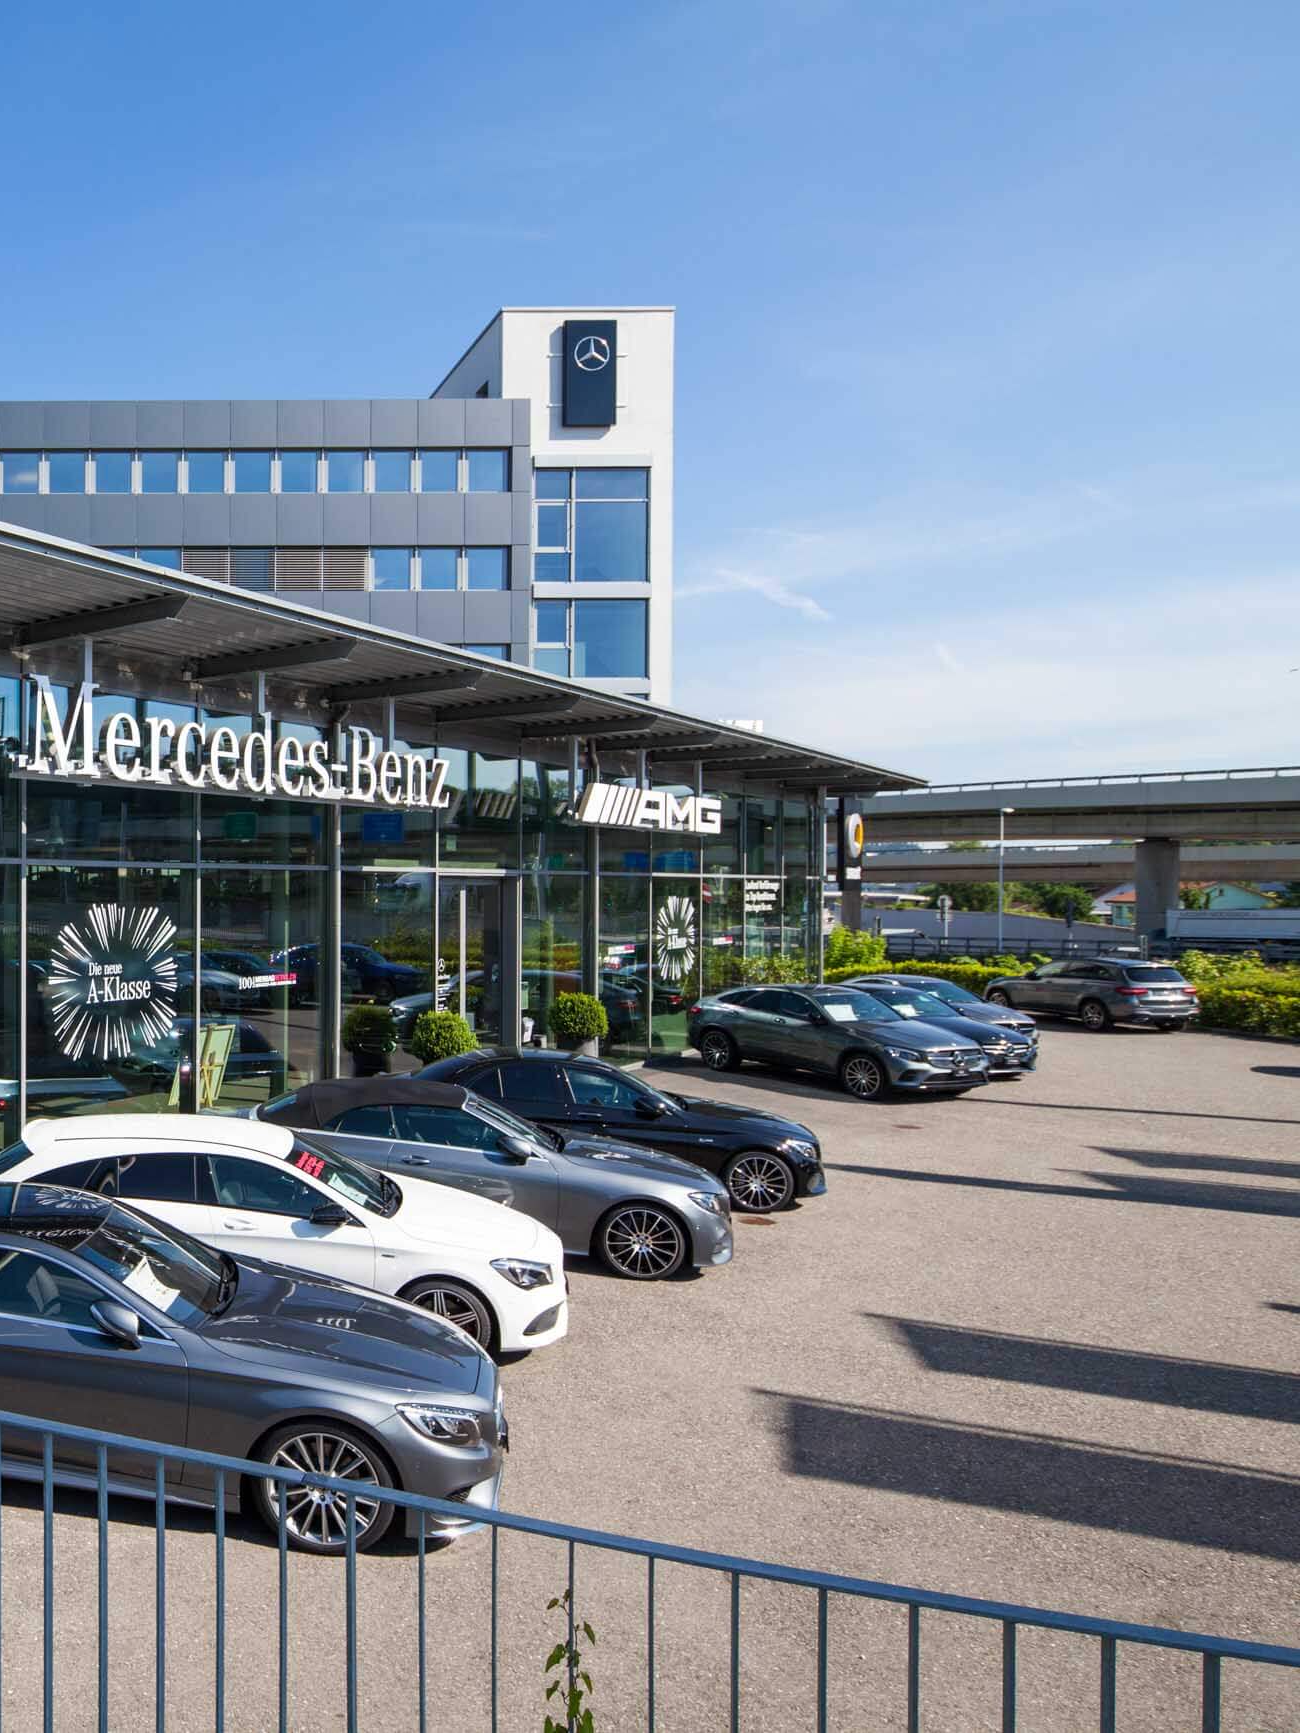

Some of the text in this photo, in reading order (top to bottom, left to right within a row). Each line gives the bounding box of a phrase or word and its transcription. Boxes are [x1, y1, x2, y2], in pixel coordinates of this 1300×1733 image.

[24, 673, 450, 808] Mercedes-Benz
[632, 789, 722, 834] AMG
[88, 962, 123, 976] Die neue
[86, 976, 151, 1004] A-Klasse
